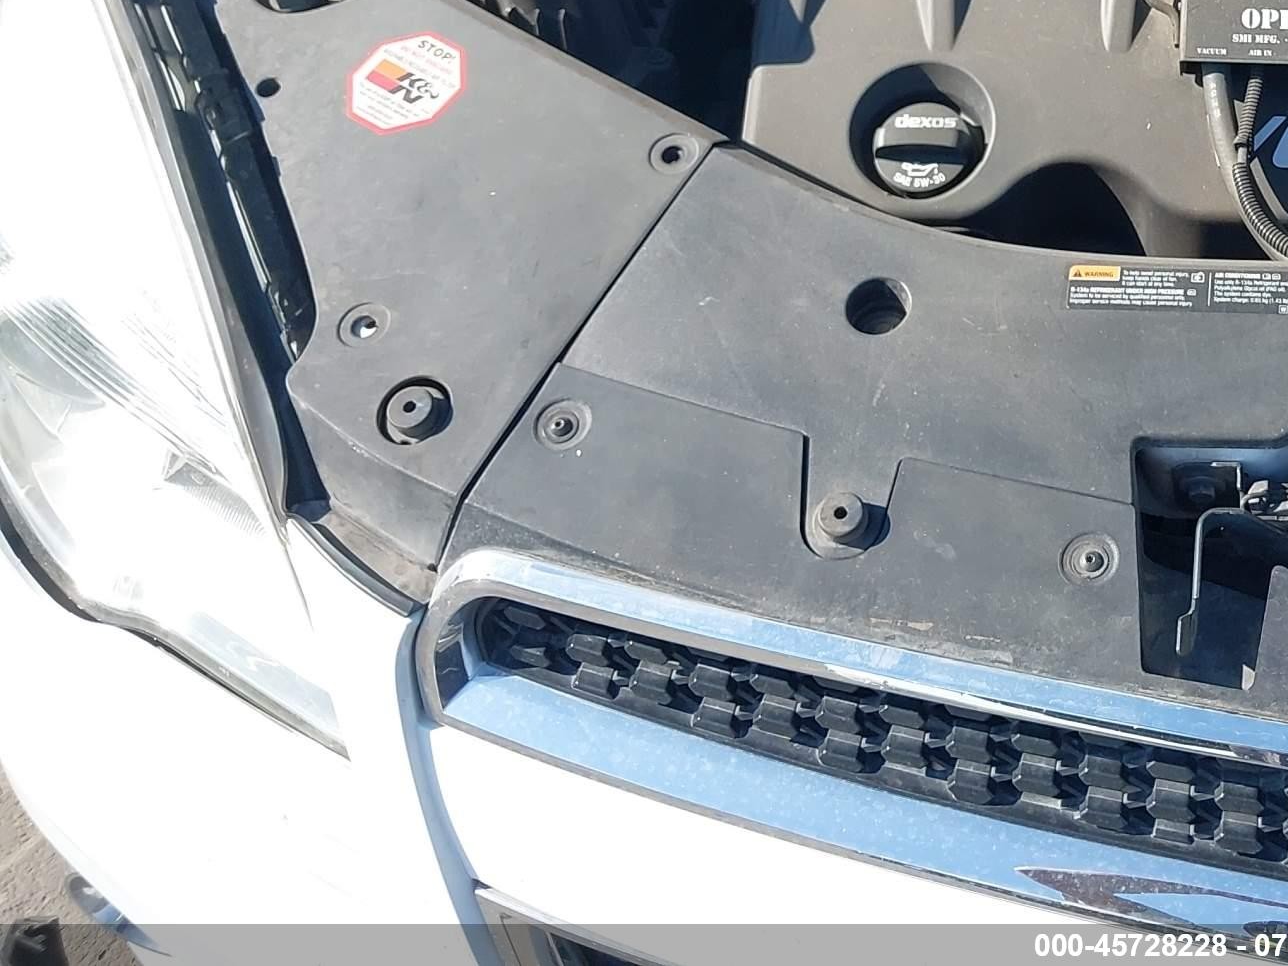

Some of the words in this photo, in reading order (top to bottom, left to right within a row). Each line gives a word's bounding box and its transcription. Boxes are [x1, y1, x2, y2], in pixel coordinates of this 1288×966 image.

[1232, 34, 1252, 44] SMI
[1196, 47, 1227, 57] VACUUM
[1248, 49, 1262, 57] AIR
[895, 114, 960, 129] dexos
[1084, 270, 1114, 278] WARNING
